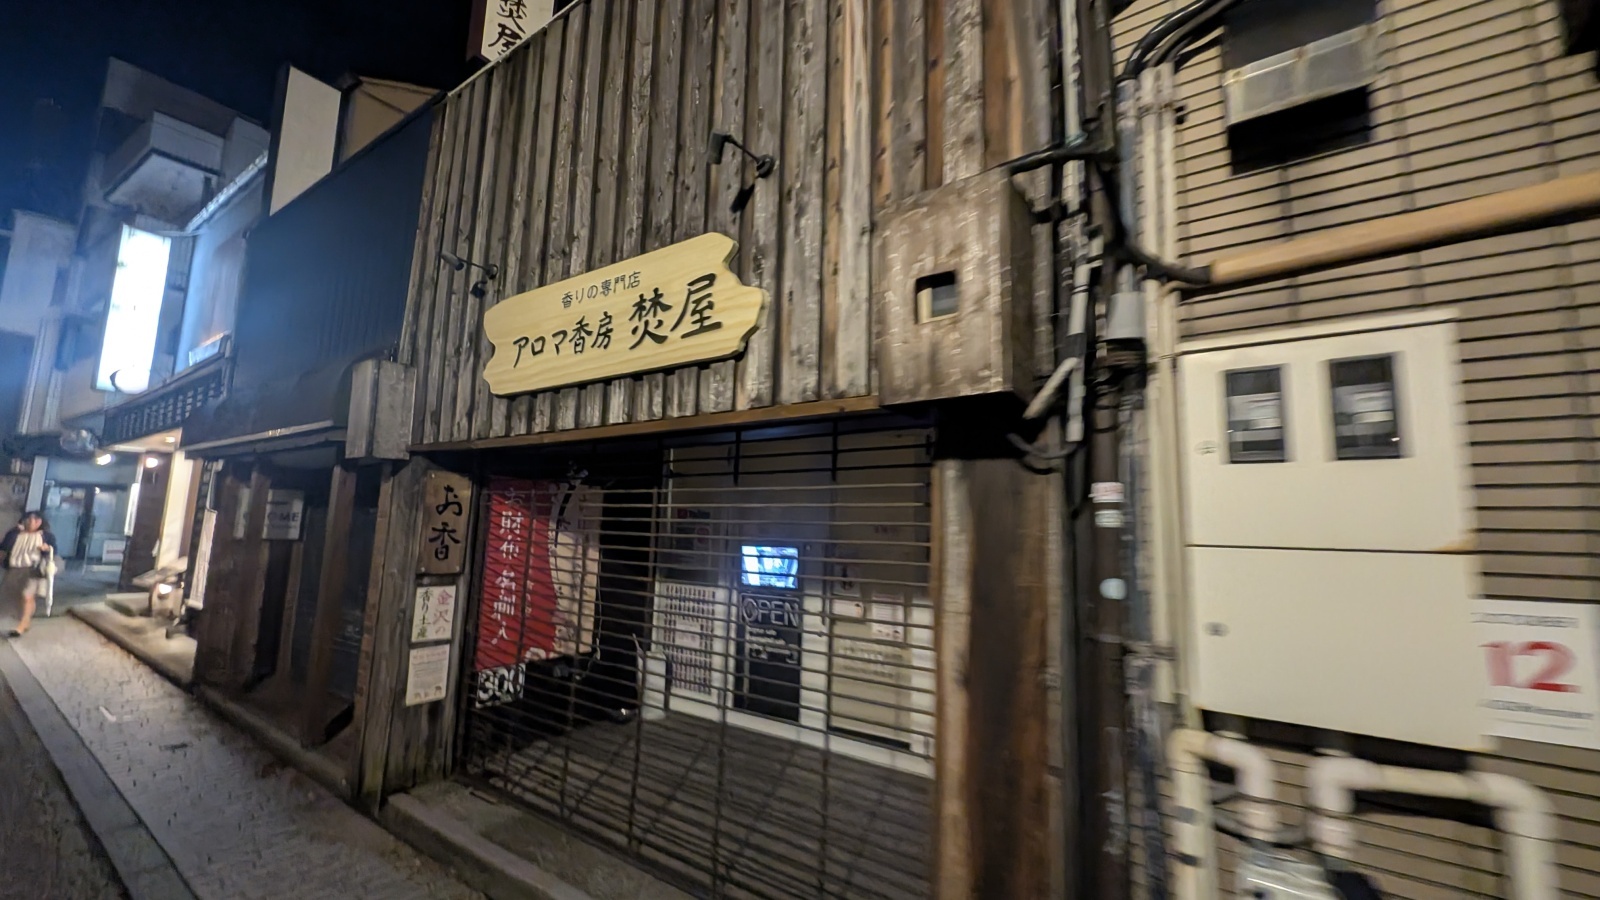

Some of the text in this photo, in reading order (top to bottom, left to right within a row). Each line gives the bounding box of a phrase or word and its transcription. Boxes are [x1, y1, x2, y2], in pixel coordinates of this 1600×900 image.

[561, 271, 642, 309] 香りの専門店
[512, 272, 723, 369] アロマ香房 焚屋
[428, 484, 463, 562] お香
[415, 587, 434, 640] 香り土産
[432, 588, 453, 635] 金沢の
[743, 597, 799, 627] OPEN
[1479, 640, 1581, 693] 12
